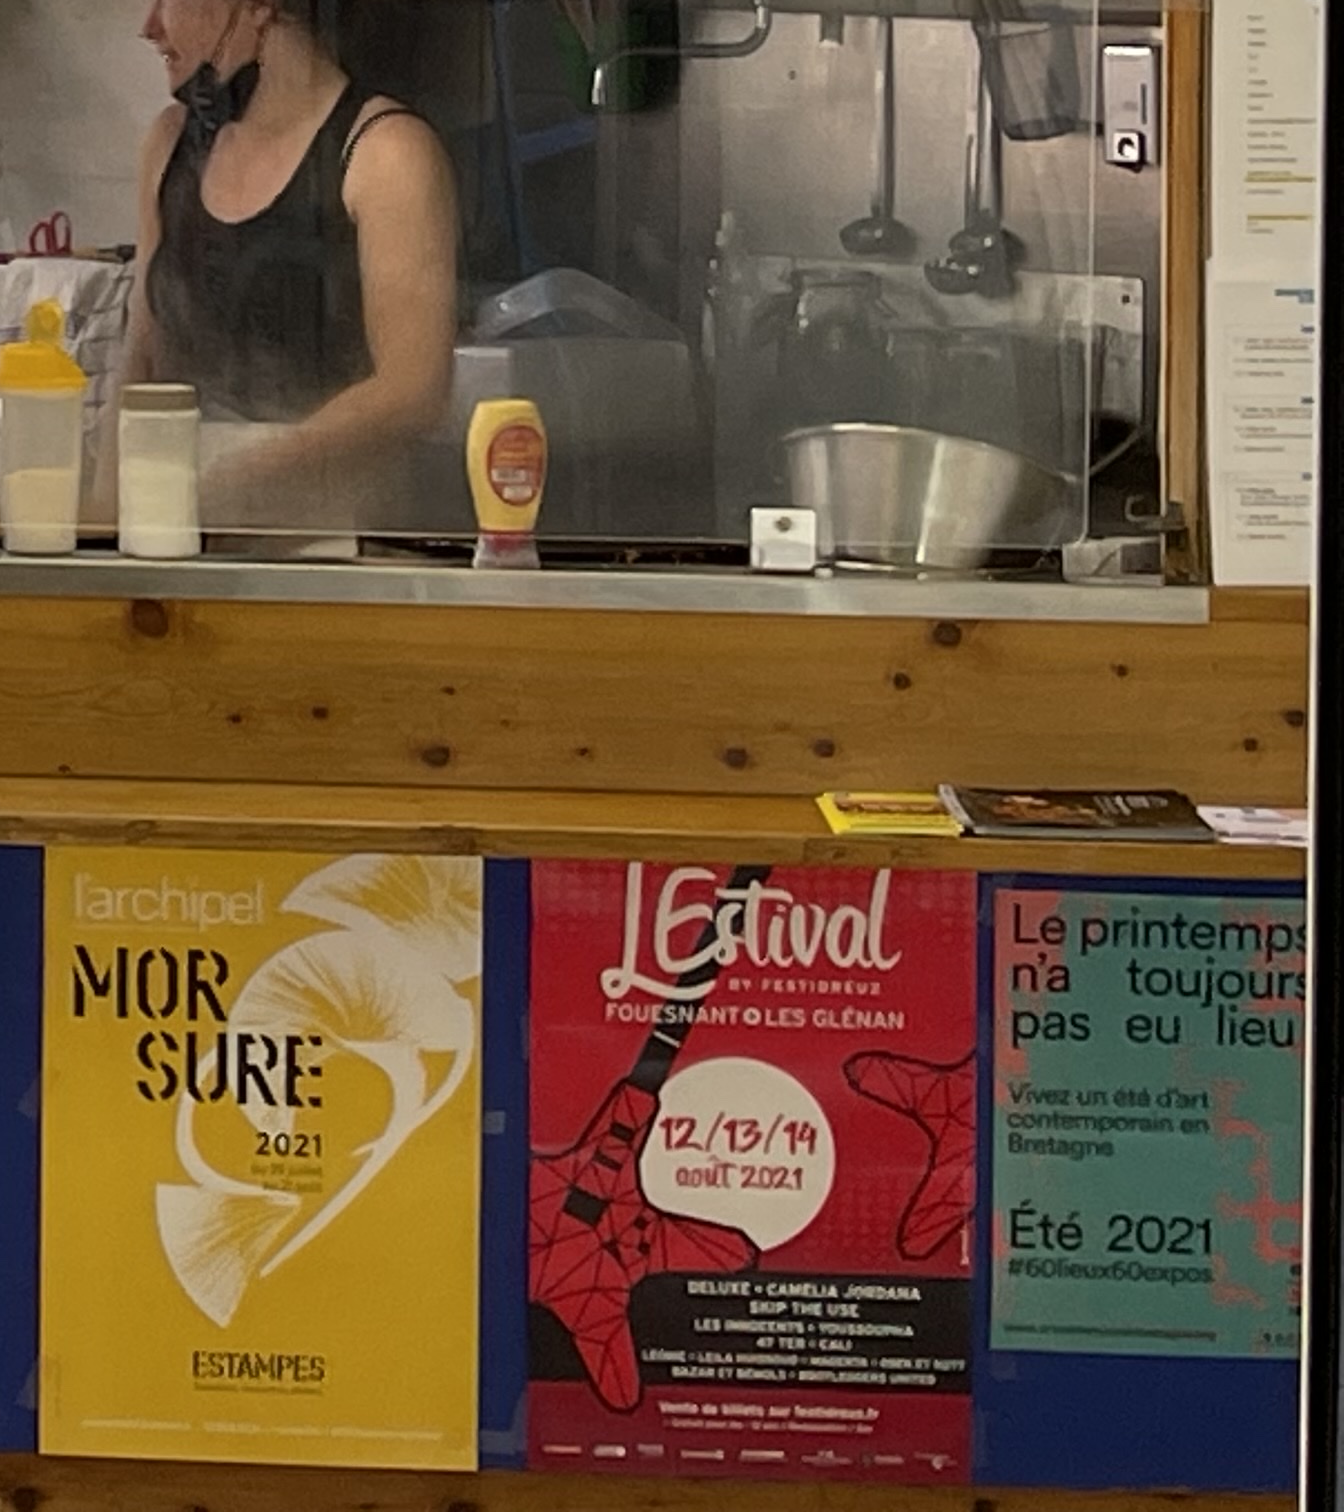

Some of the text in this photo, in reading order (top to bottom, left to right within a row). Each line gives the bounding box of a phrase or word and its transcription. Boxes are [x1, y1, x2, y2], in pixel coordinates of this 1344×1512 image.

[1014, 903, 1066, 945] Le
[72, 944, 230, 1023] MOR
[729, 977, 752, 992] BY
[1013, 951, 1071, 994] n'a
[605, 1002, 906, 1031] FOUESNANT LES GLÉNAN
[1012, 1003, 1295, 1050] pas eu lieu
[135, 1031, 323, 1108] SURE
[1009, 1082, 1209, 1110] Vivez un été d'art
[660, 1111, 818, 1156] 12/13/14
[1007, 1111, 1210, 1135] contemporain en
[255, 1131, 323, 1159] 2021
[1007, 1133, 1115, 1161] Bretagne
[740, 1166, 803, 1191] 2021
[1009, 1198, 1212, 1255] Été 2021
[687, 1279, 752, 1296] DELUXE
[842, 1283, 922, 1302] JORDANA
[749, 1299, 860, 1319] SKIP THE USE
[693, 1317, 722, 1333] LES
[191, 1350, 326, 1382] ESTAMPES
